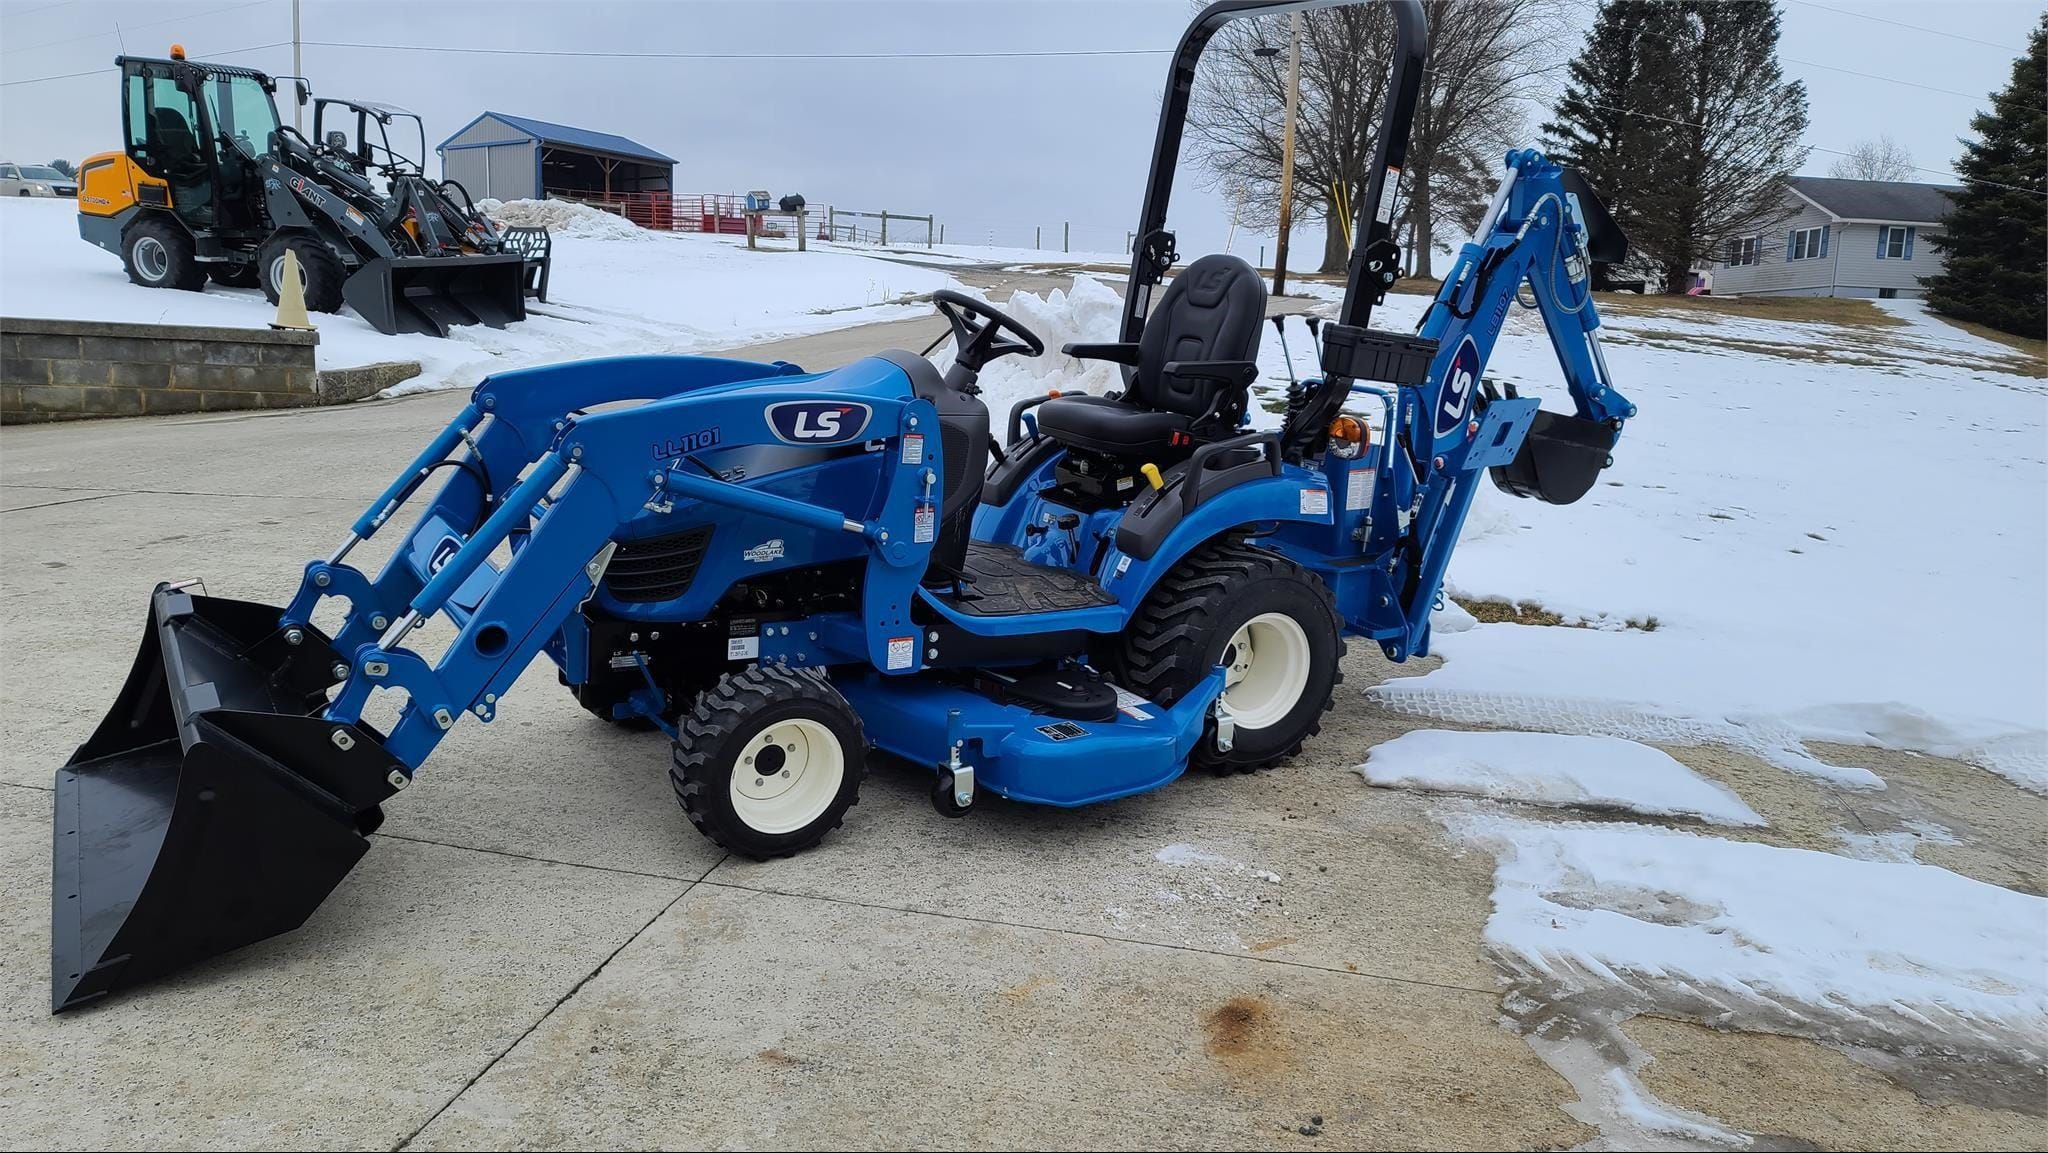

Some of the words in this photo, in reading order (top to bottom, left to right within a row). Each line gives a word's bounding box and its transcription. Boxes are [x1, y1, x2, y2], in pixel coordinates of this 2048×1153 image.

[1487, 288, 1511, 338] LB1107
[1443, 367, 1472, 420] LS
[652, 426, 722, 461] LL1101
[793, 411, 842, 438] LS
